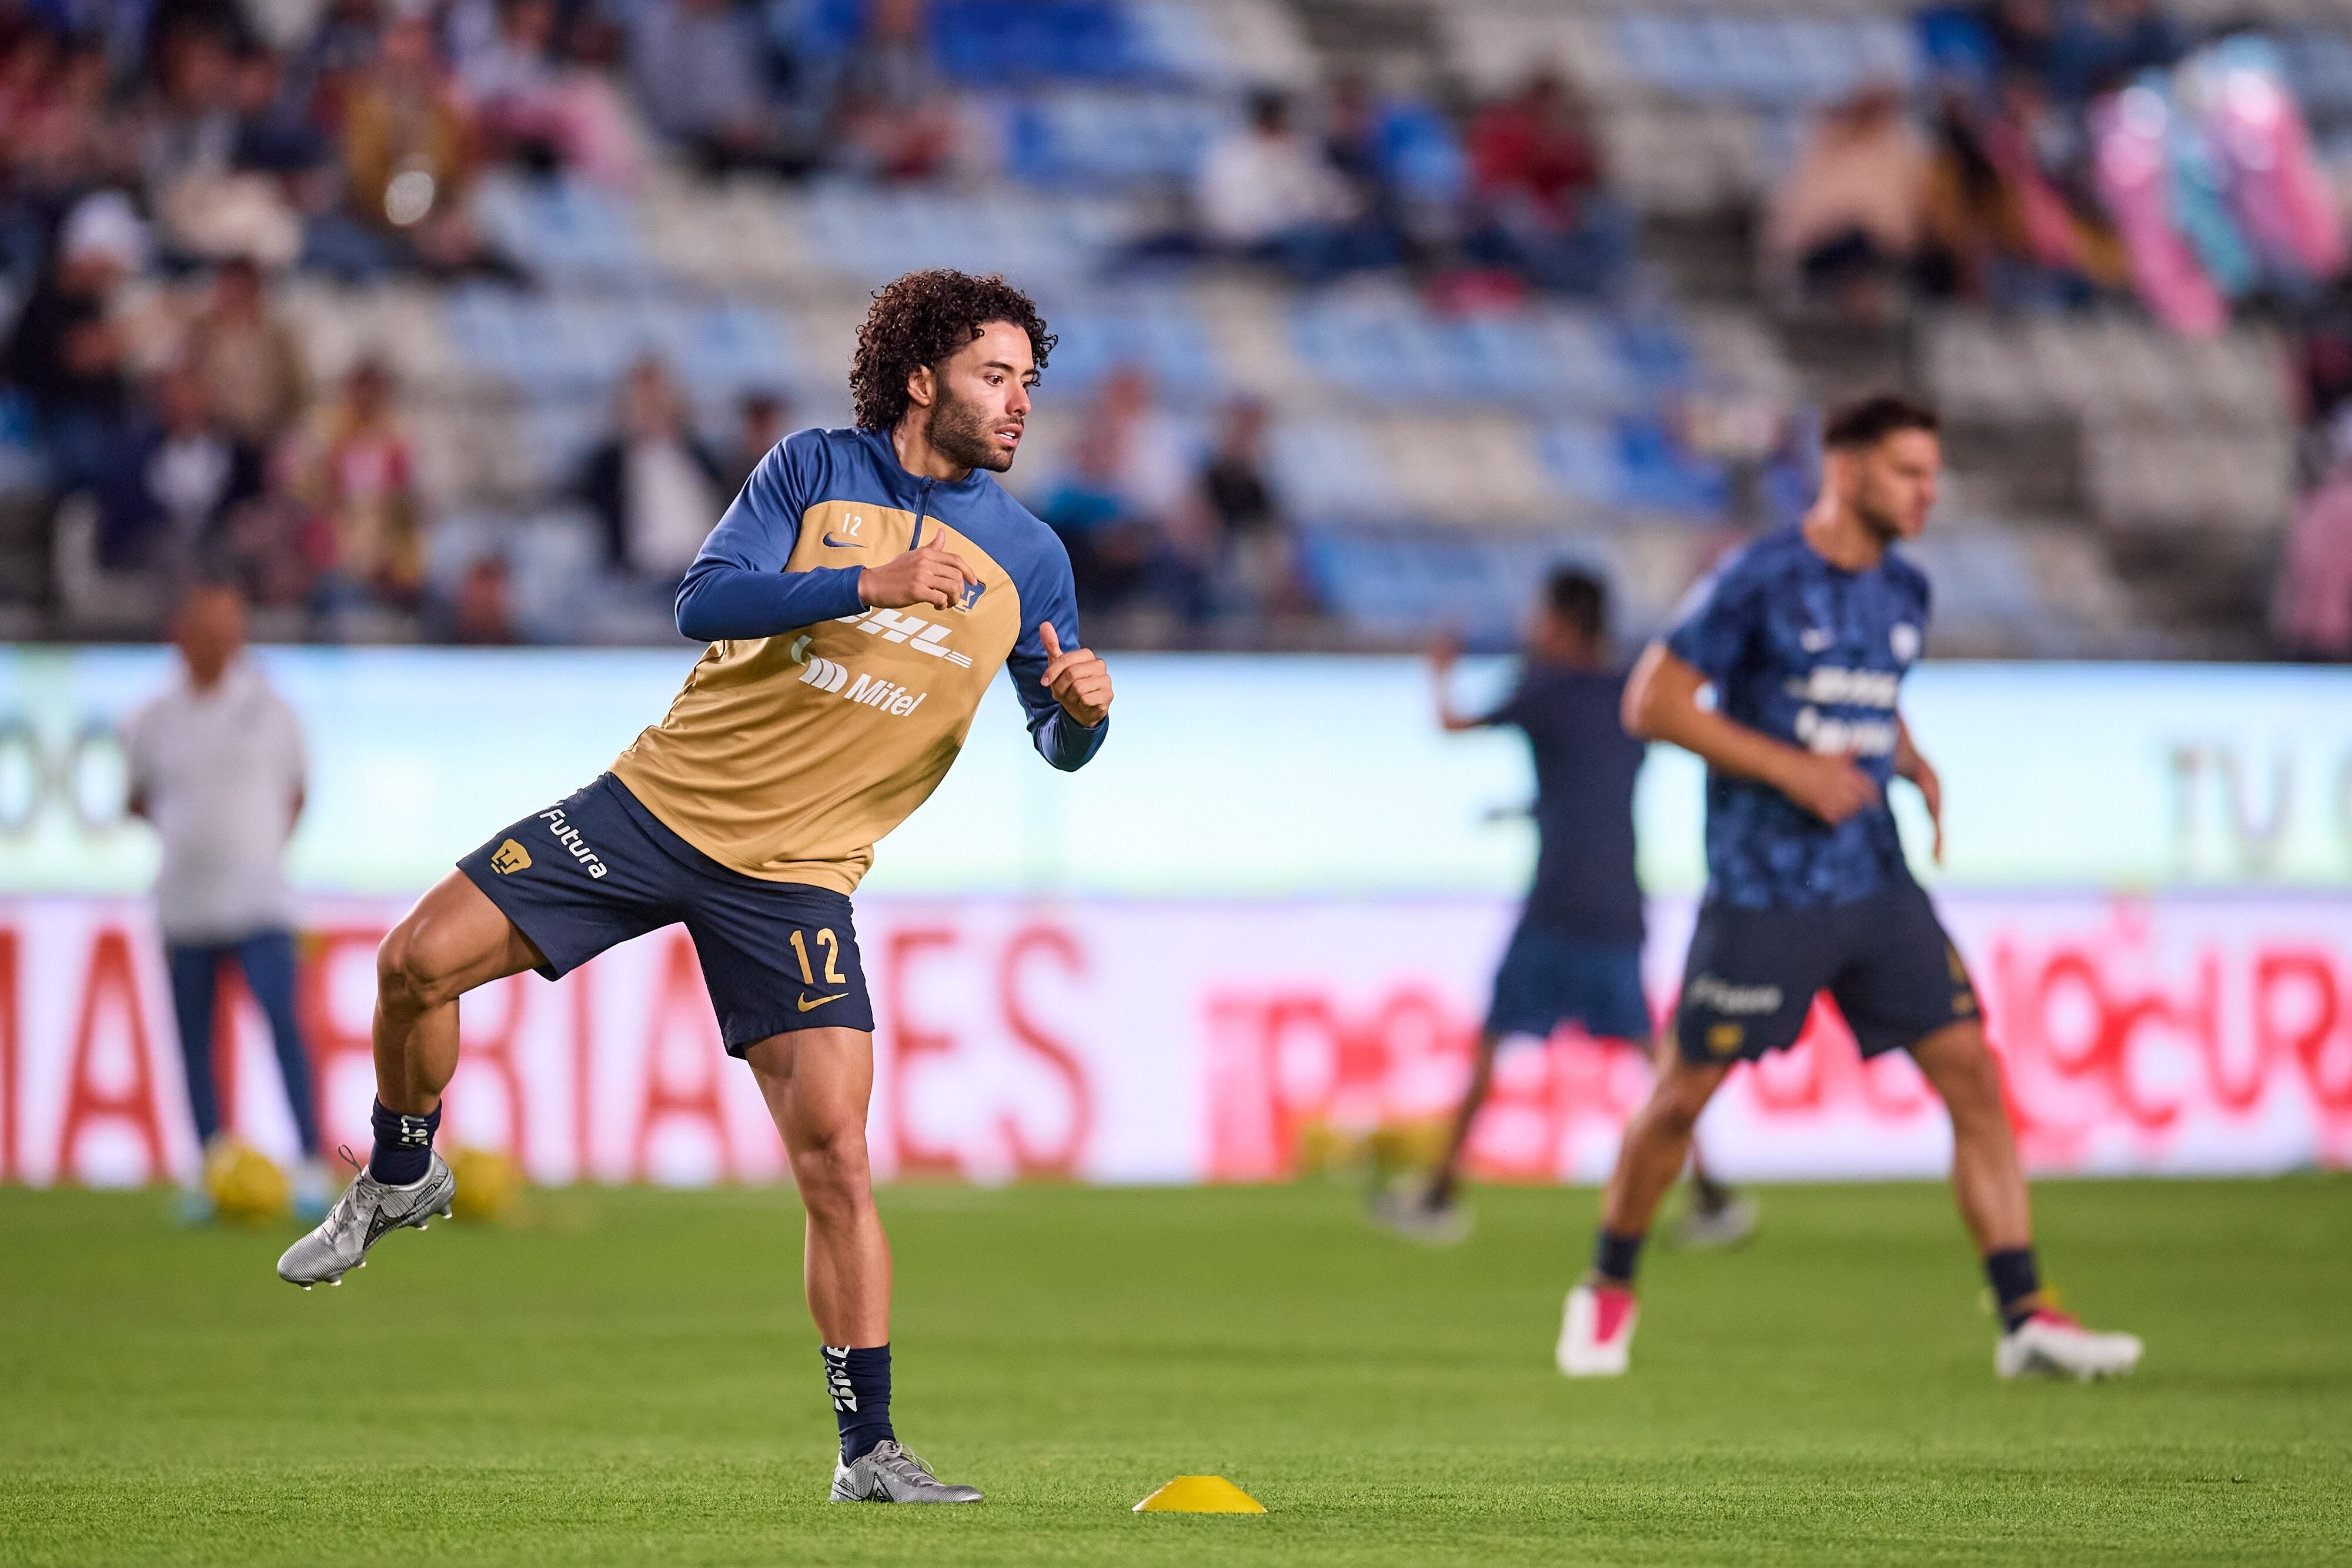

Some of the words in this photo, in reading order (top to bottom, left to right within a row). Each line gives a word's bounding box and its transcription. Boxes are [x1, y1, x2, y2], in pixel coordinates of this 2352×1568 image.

[841, 512, 863, 537] 12
[843, 673, 928, 717] Mifel
[539, 808, 608, 879] Futura
[789, 927, 847, 985] 12
[0, 924, 1098, 1181] AERIAES
